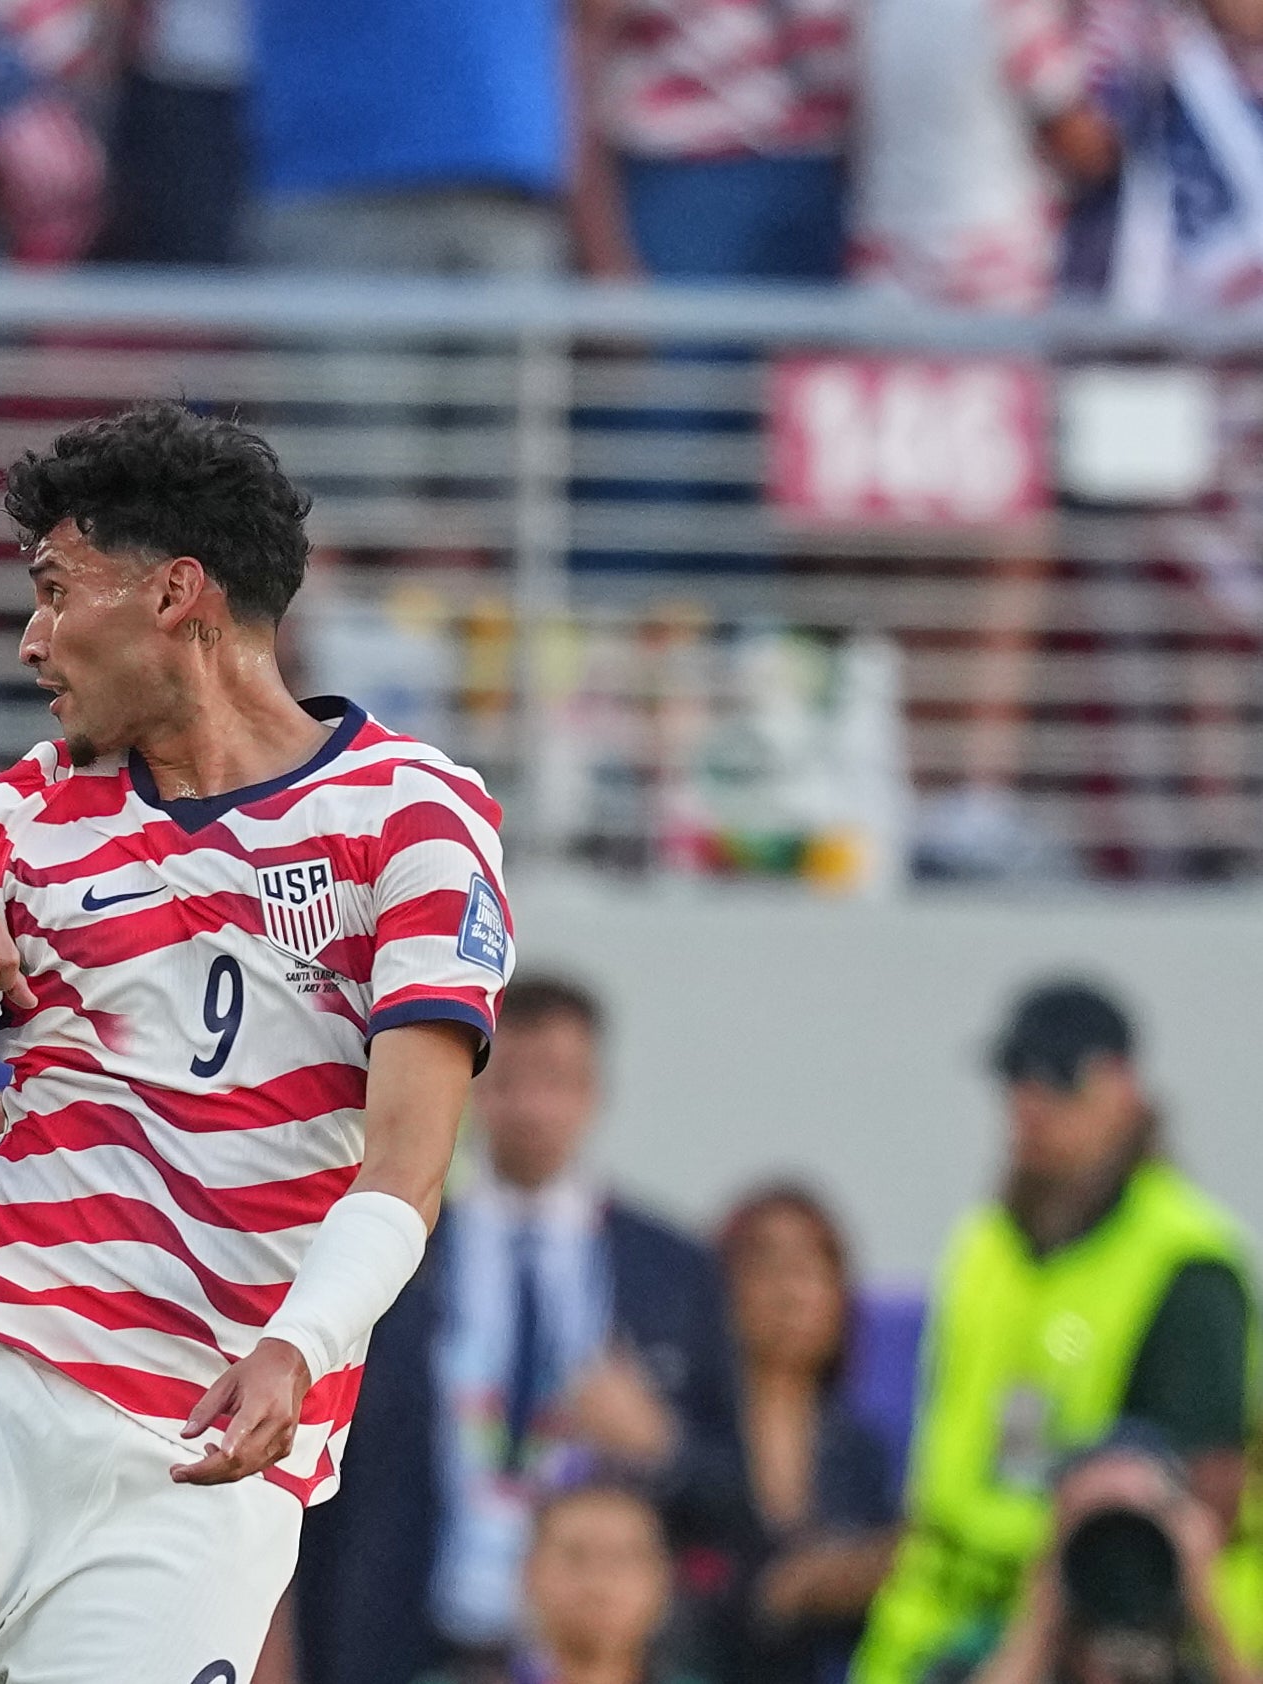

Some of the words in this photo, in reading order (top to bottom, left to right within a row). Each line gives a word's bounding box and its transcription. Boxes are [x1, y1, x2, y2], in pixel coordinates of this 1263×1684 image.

[263, 864, 329, 905] USA
[285, 971, 311, 982] SANTA
[303, 983, 321, 993] JULY
[190, 954, 244, 1078] 9
